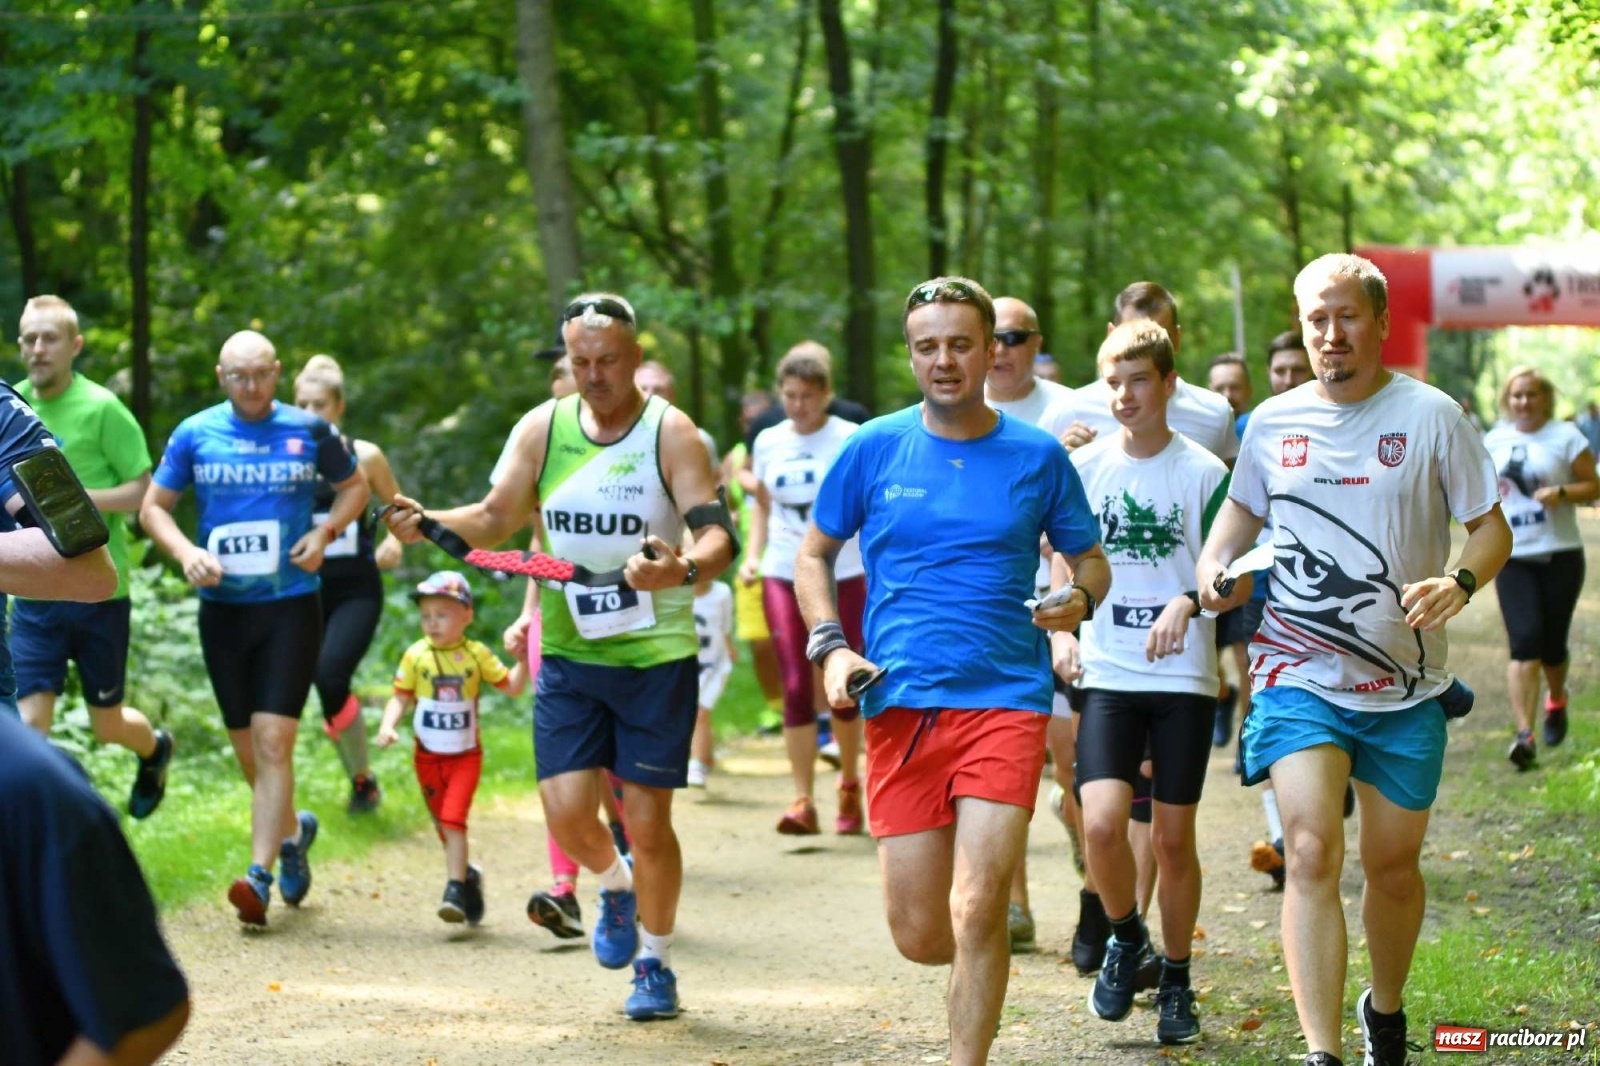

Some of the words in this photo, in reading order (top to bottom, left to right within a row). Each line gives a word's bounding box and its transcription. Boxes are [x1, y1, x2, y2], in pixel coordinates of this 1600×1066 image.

[546, 509, 643, 535] IRBUD
[225, 535, 261, 554] 112
[591, 592, 621, 612] 70
[1125, 608, 1154, 627] 42
[431, 713, 465, 728] 113
